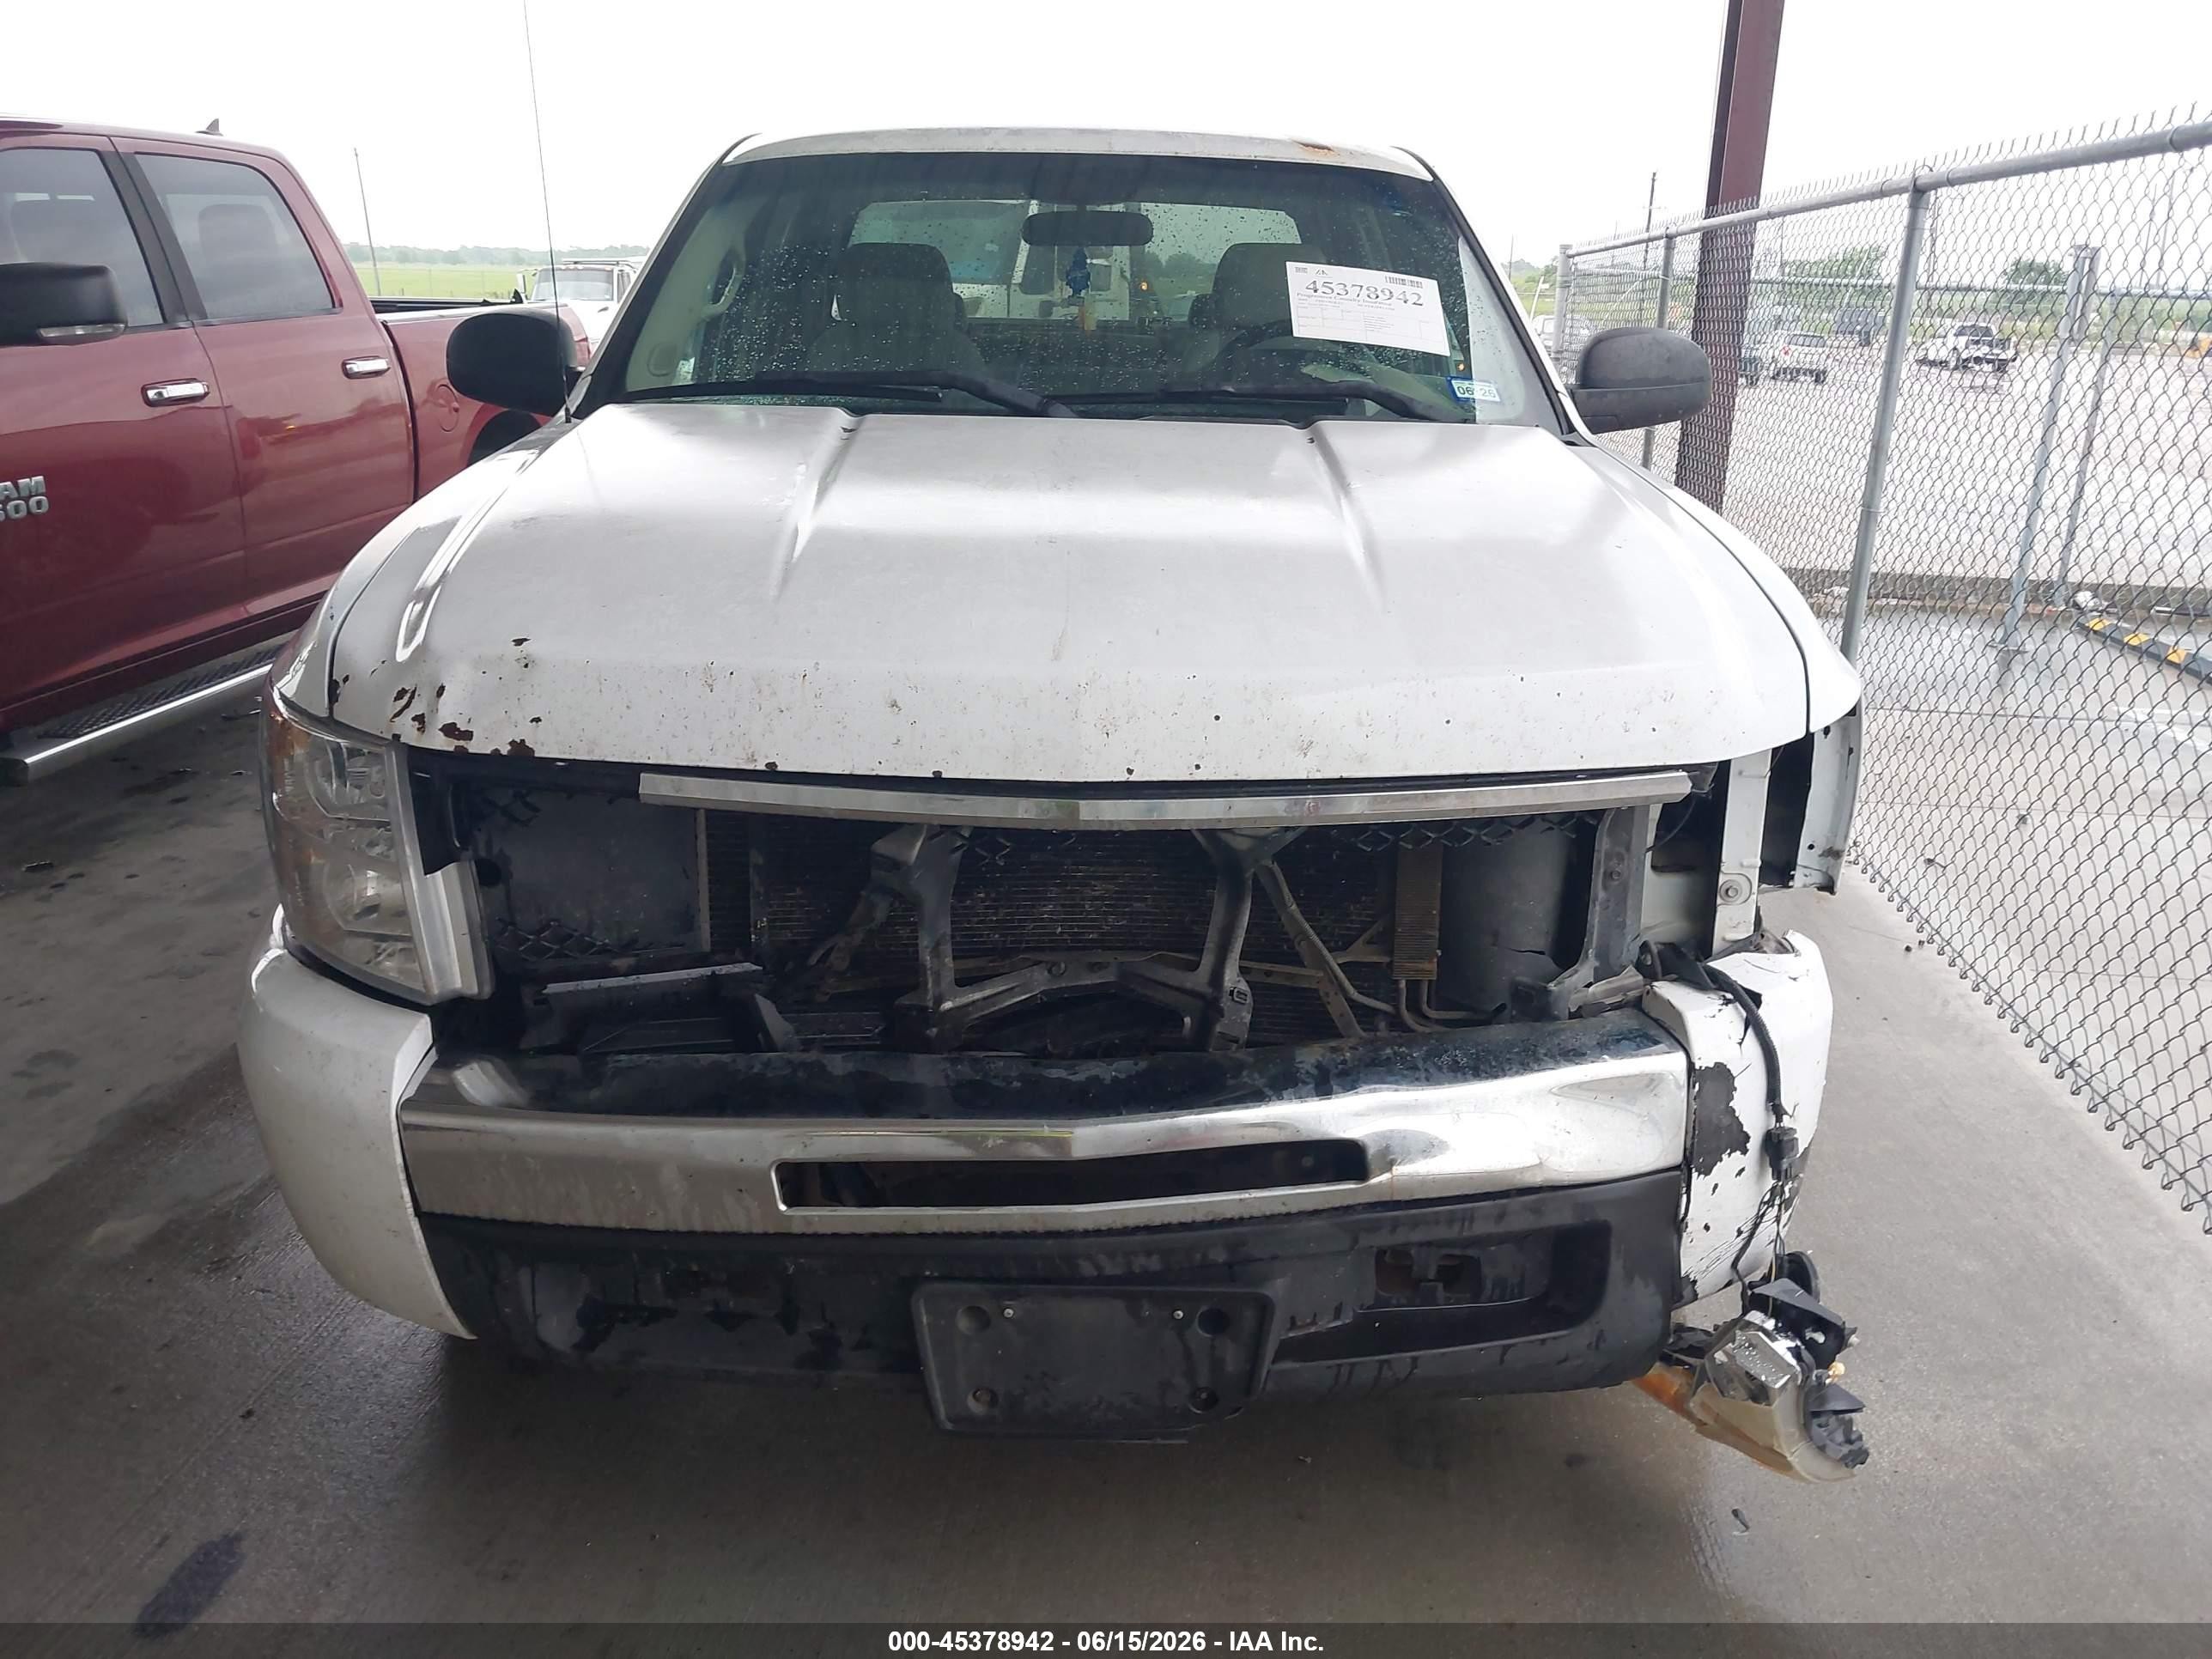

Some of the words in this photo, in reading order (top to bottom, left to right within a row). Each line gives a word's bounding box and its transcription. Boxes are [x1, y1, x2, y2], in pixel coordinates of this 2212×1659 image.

[1305, 279, 1424, 307] 45378942
[1457, 386, 1475, 396] 06
[0, 475, 46, 500] AM
